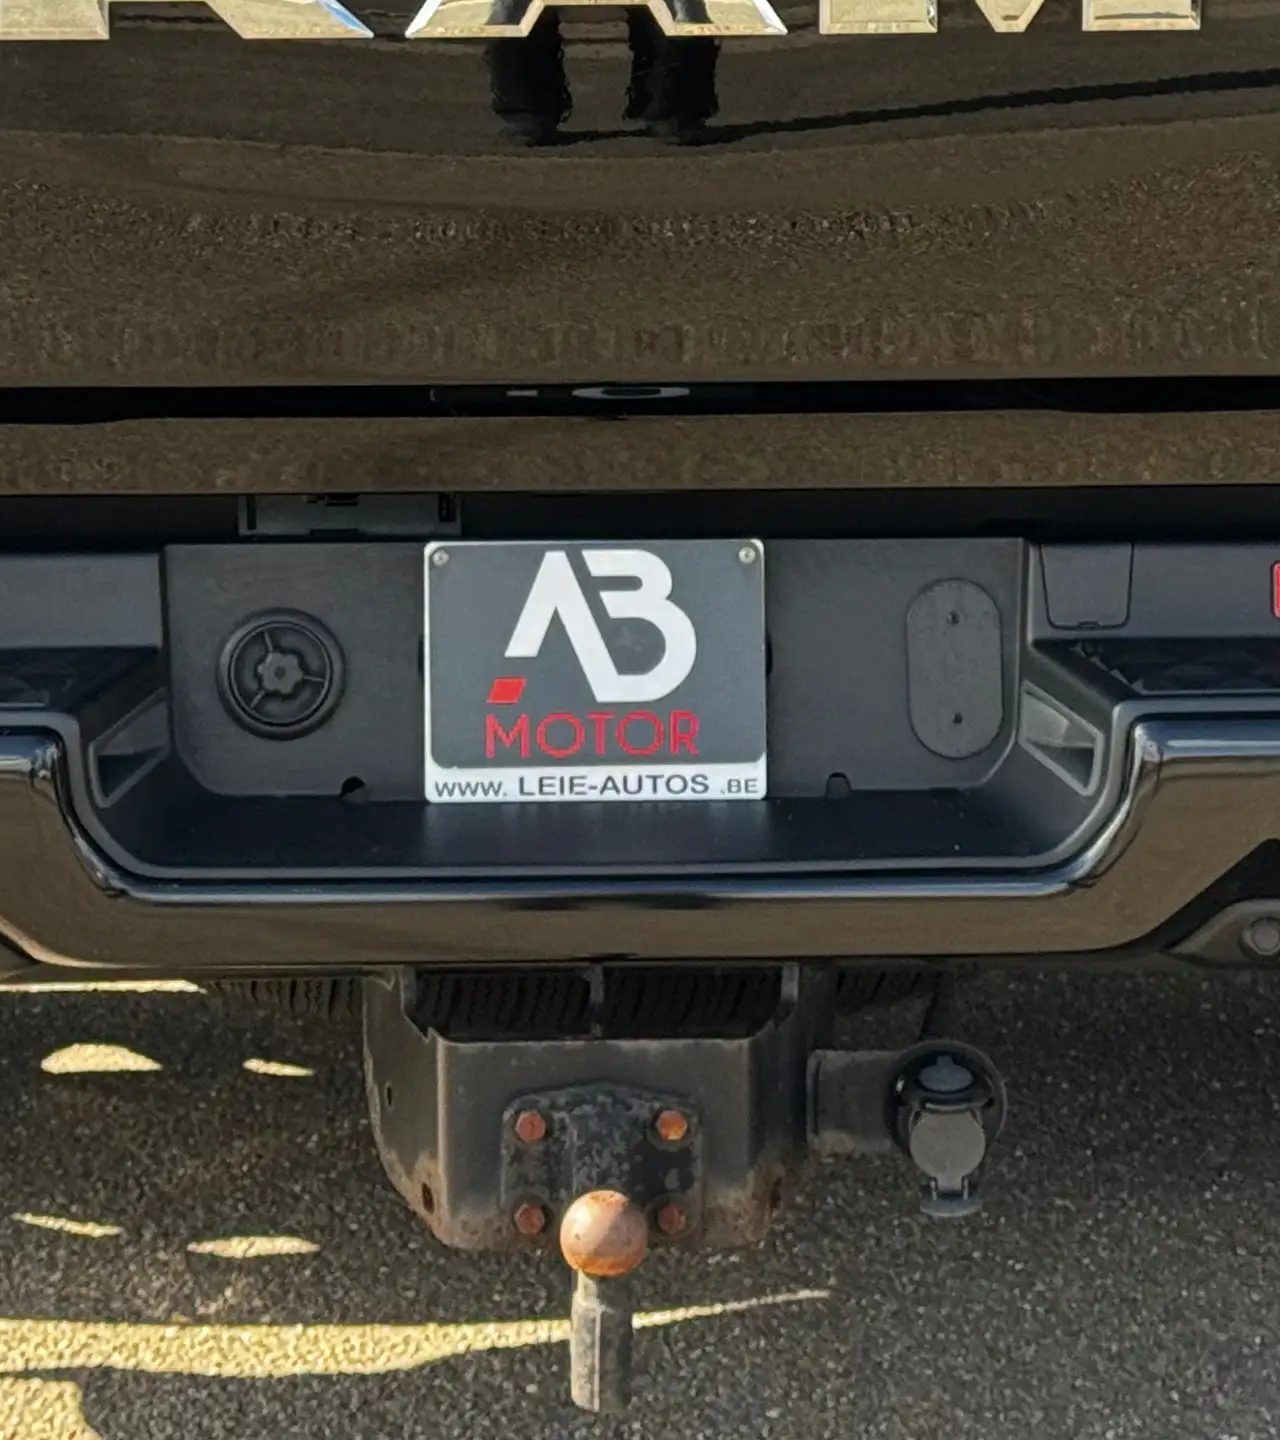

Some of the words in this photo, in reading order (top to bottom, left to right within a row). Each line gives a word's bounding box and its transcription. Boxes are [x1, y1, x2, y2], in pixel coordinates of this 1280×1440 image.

[487, 549, 697, 704] AB
[485, 710, 700, 759] MOTOR
[518, 773, 710, 797] LEIE-AUTOS
